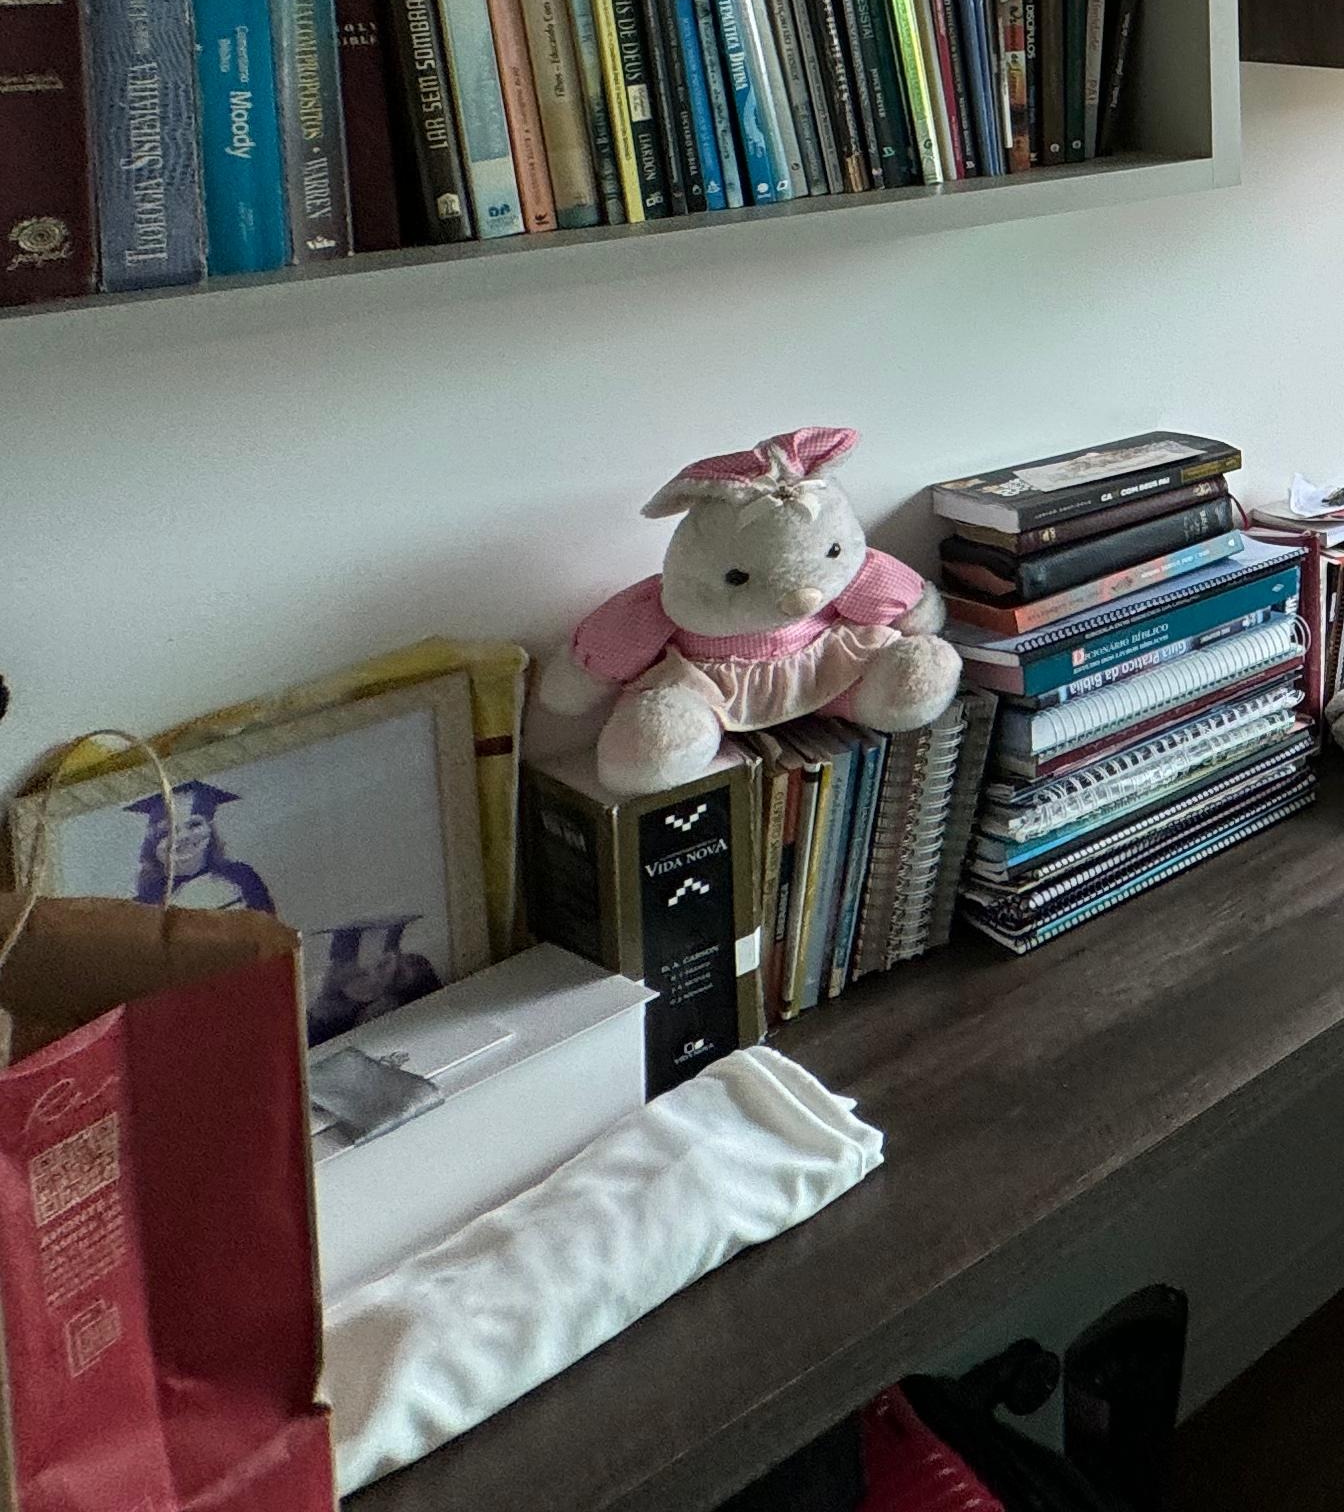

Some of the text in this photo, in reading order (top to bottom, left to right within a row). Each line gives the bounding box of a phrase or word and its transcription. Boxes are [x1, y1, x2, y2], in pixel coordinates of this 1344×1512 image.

[616, 17, 636, 38] DE
[620, 41, 643, 81] DEUS
[728, 50, 752, 90] DIVINA
[421, 75, 443, 112] SEM
[225, 90, 255, 160] Moody
[425, 115, 449, 150] LAR
[303, 156, 333, 220] WARREN
[125, 178, 169, 267] TEOLOGIA
[1131, 623, 1169, 644] BÍBLICO
[1160, 640, 1187, 657] Guia
[1104, 668, 1119, 682] da
[644, 838, 729, 878] VIDA NOVA
[683, 944, 720, 965] CARSON
